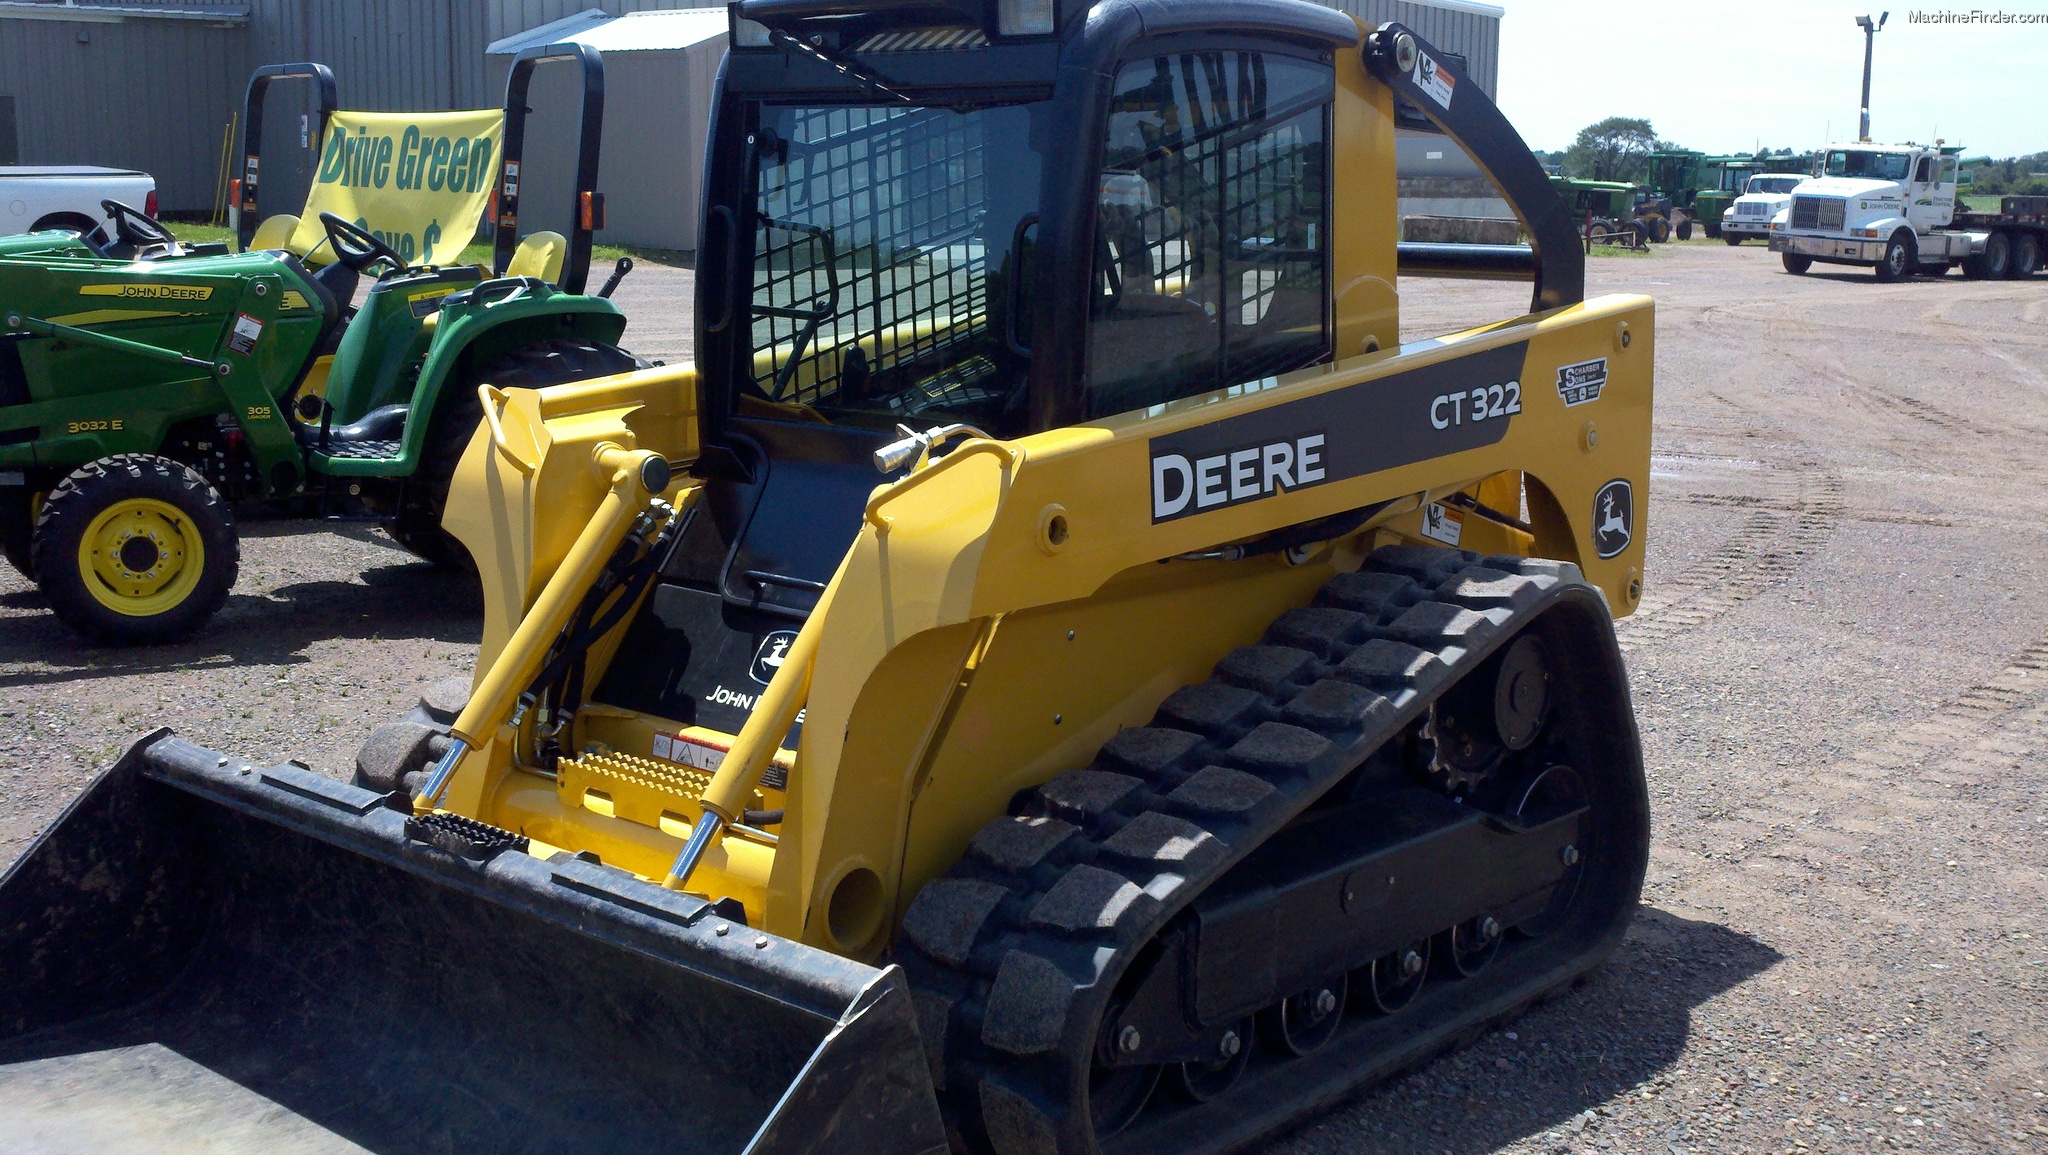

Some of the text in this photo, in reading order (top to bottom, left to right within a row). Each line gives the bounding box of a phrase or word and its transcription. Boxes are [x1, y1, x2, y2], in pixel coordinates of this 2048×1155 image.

[318, 126, 393, 189] Drive
[396, 125, 492, 193] Green
[117, 285, 207, 300] JOHN DEERE
[247, 407, 271, 415] 305
[1430, 381, 1522, 430] CT 322
[68, 419, 123, 434] 3032 E
[1153, 434, 1326, 518] DEERE
[705, 684, 753, 710] JOHN
